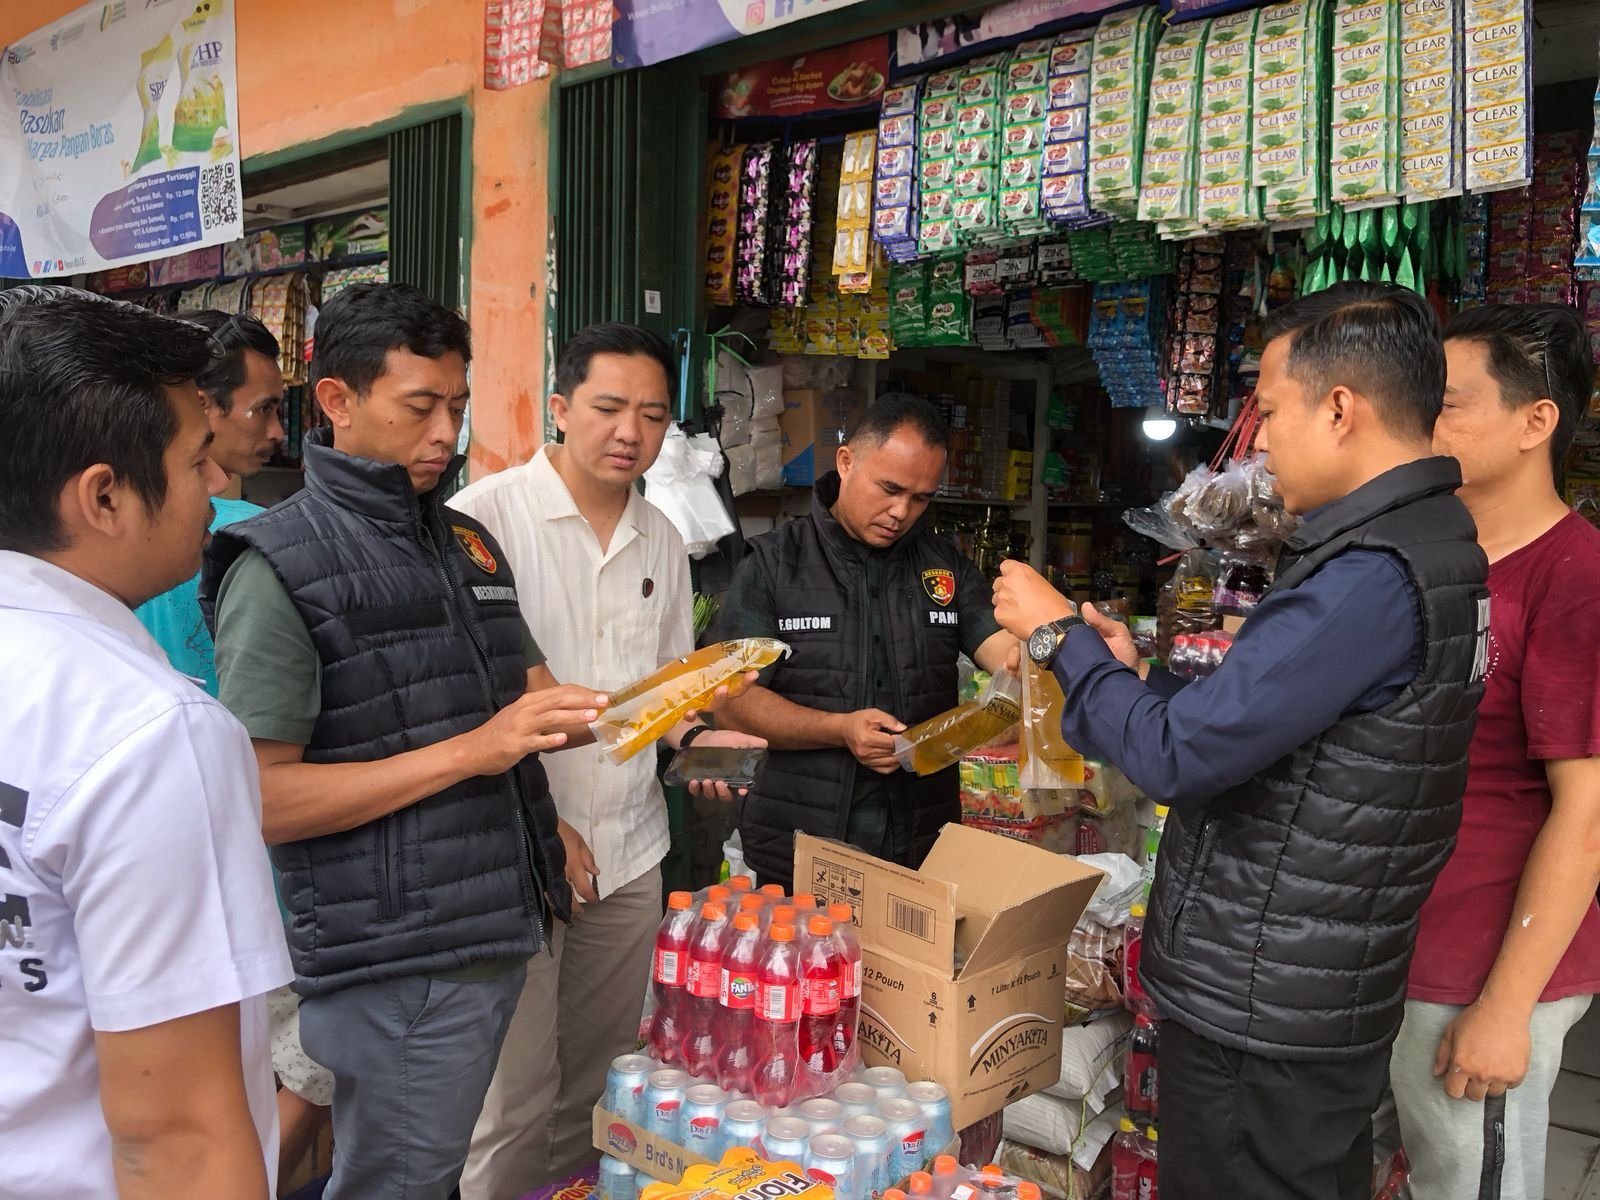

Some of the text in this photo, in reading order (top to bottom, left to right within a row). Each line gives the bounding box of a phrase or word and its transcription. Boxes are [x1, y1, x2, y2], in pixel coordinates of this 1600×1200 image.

[1264, 5, 1301, 22] CLEAR
[1341, 6, 1382, 25] CLEAR
[1404, 0, 1445, 15] CLEAR
[1472, 24, 1517, 43] CLEAR
[1209, 43, 1244, 58] CLEAR
[1259, 38, 1297, 54] CLEAR
[1340, 45, 1381, 63] CLEAR
[1404, 37, 1446, 55] CLEAR
[1160, 48, 1192, 64] CLEAR
[1472, 64, 1518, 83] CLEAR
[1207, 79, 1242, 94] CLEAR
[1259, 75, 1297, 91] CLEAR
[1404, 76, 1446, 94] CLEAR
[1096, 91, 1128, 105] CLEAR
[1340, 83, 1379, 101] CLEAR
[1258, 113, 1296, 129] CLEAR
[1472, 105, 1518, 123] CLEAR
[1151, 118, 1184, 131] CLEAR
[1339, 121, 1379, 138] CLEAR
[1403, 115, 1444, 133] CLEAR
[89, 122, 114, 149] Beras
[1147, 153, 1181, 166] CLEAR
[1204, 151, 1240, 165] CLEAR
[1257, 149, 1296, 164] CLEAR
[1472, 146, 1518, 163] CLEAR
[1337, 159, 1378, 176] CLEAR
[1402, 155, 1443, 172] CLEAR
[1144, 188, 1178, 200] CLEAR
[1203, 187, 1239, 200] CLEAR
[1045, 249, 1065, 258] ZINC
[973, 268, 992, 277] ZINC
[935, 306, 953, 314] MILO
[779, 617, 831, 631] F.GULTOM
[863, 967, 874, 979] 12
[875, 971, 905, 991] Pouch
[996, 983, 1010, 994] Liter
[1016, 976, 1023, 985] 12
[1024, 971, 1041, 982] Pouch
[931, 992, 937, 1000] 6
[981, 1028, 1048, 1073] MINYAKITA
[646, 1143, 674, 1172] Bird's
